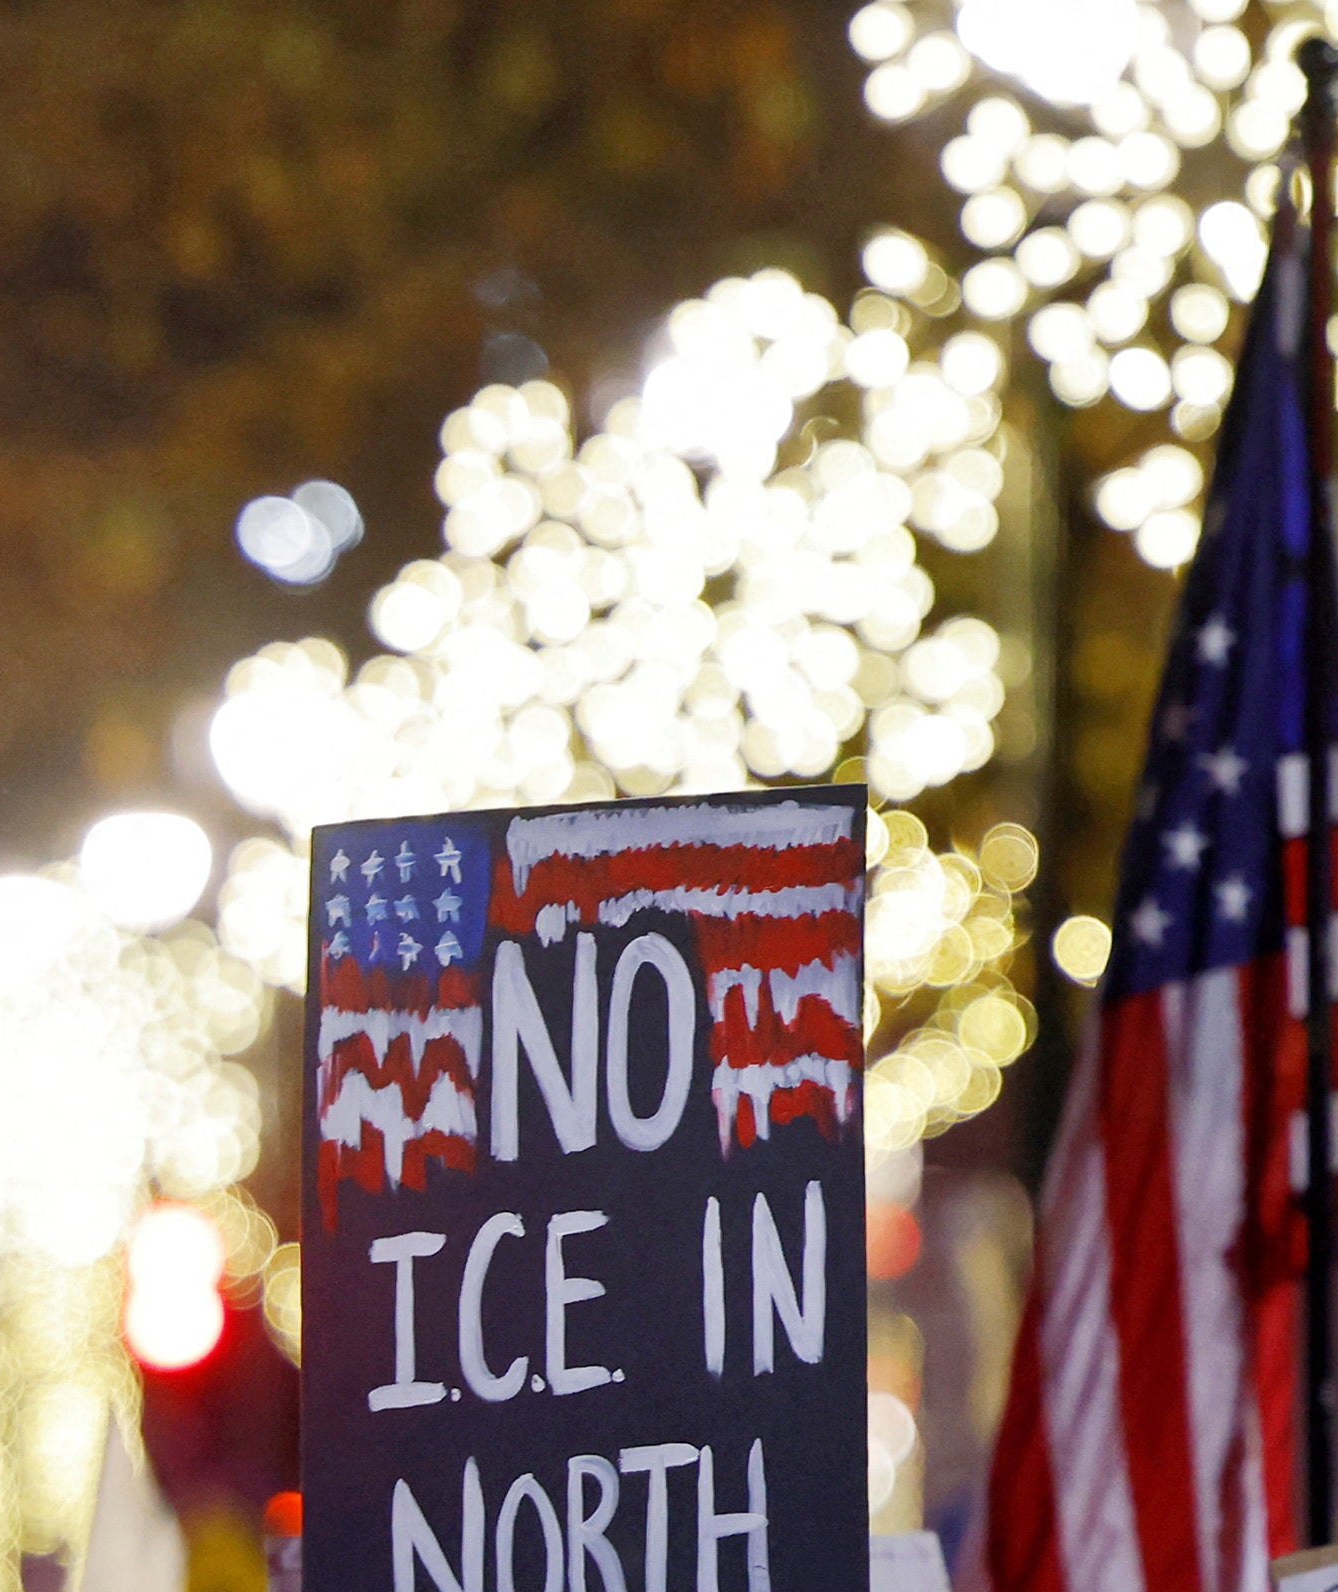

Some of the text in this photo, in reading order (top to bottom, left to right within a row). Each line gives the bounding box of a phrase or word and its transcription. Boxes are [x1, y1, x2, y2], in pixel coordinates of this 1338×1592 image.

[489, 932, 696, 1162] NO
[368, 1179, 828, 1412] I.C.E. IN
